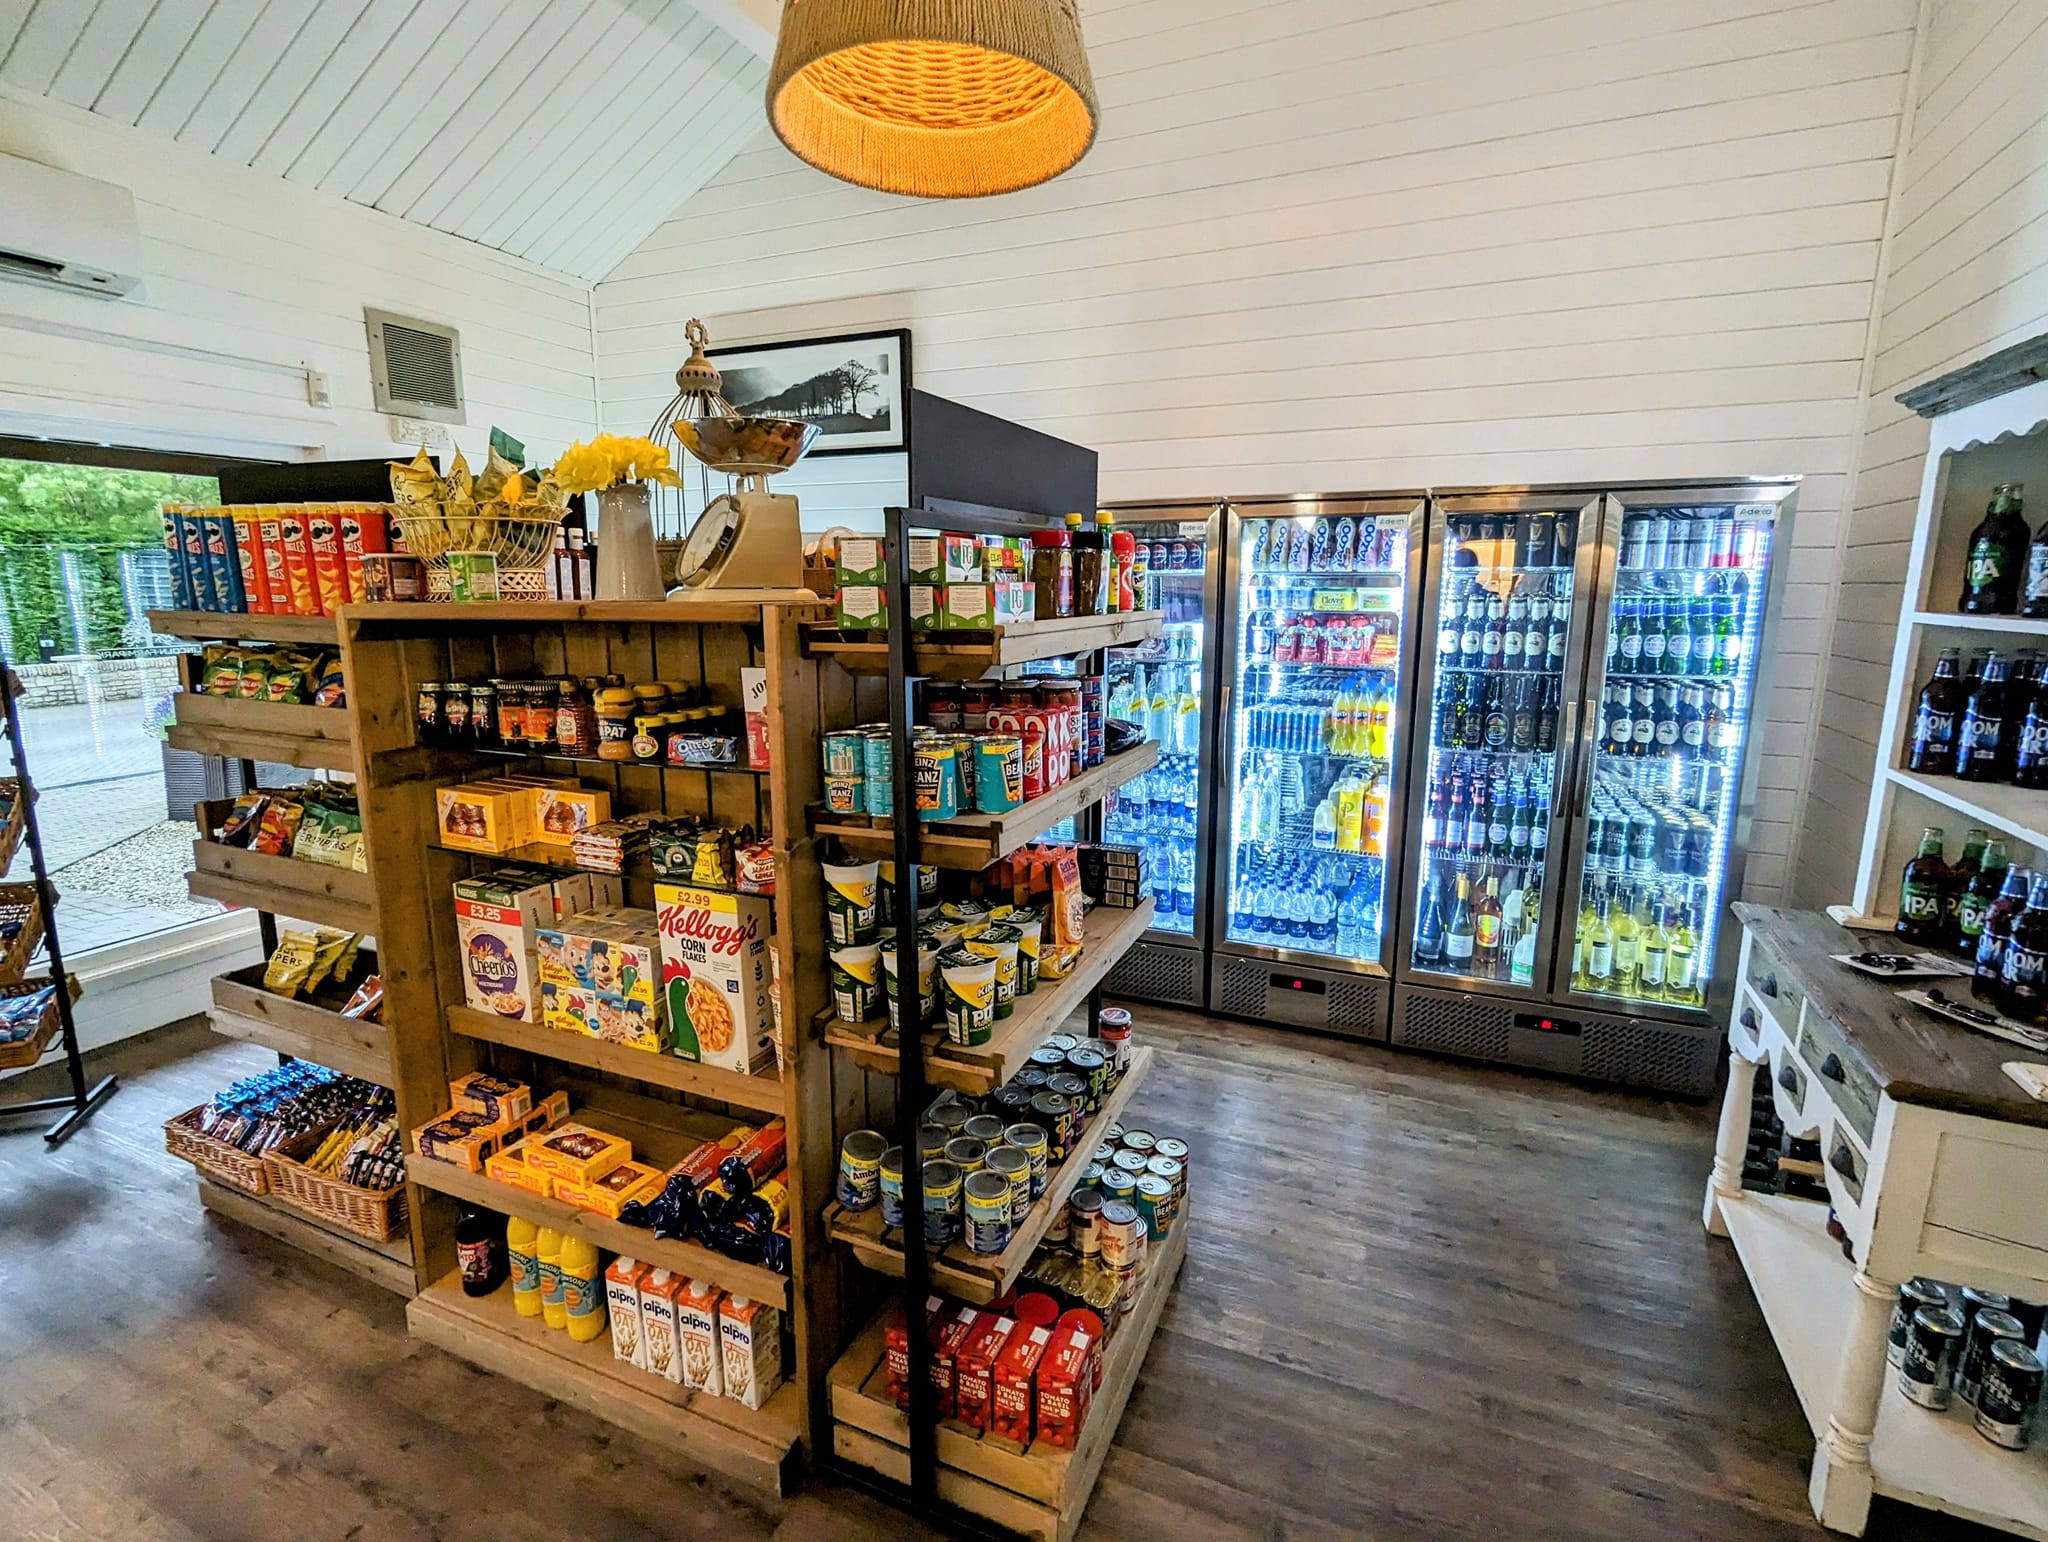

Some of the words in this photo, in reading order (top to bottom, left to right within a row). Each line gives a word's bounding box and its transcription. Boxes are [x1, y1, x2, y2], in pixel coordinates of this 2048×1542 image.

[1271, 526, 1287, 563] YAZOO
[1289, 531, 1305, 563] YAZO
[1311, 526, 1327, 563] YAZOO
[1332, 525, 1351, 563] YAZOO
[1354, 524, 1375, 563] YAZOO
[963, 544, 972, 565] PG
[1967, 557, 2000, 581] IPA
[1012, 588, 1021, 609] PG
[1321, 595, 1344, 606] Clover
[1915, 714, 1953, 730] OOM
[1960, 719, 2000, 736] OOM
[677, 740, 713, 753] OREO
[914, 757, 936, 769] EINZ
[1006, 763, 1021, 776] BEA
[1024, 758, 1041, 776] BIS
[831, 781, 849, 790] HEINZ
[914, 771, 939, 784] ANZ
[830, 788, 853, 797] BEANZ
[755, 871, 774, 879] GINGE
[919, 870, 937, 888] PO
[677, 891, 710, 906] £2.99
[862, 885, 877, 897] KIN
[470, 904, 502, 921] £3.25
[1904, 894, 1939, 915] IPA
[1946, 898, 1962, 918] PA
[857, 906, 876, 923] PO
[659, 904, 759, 956] Kellogg's
[681, 938, 706, 953] CORN
[749, 938, 764, 952] CORN
[682, 951, 706, 963] FLAKES
[1002, 958, 1018, 973] KIN
[2004, 948, 2045, 972] OOM
[470, 956, 516, 978] Cheerios
[977, 984, 994, 998] KIN
[997, 981, 1015, 998] PO
[971, 1005, 994, 1024] PO
[853, 1167, 880, 1181] Ambr
[609, 1289, 636, 1306] alpro
[643, 1300, 672, 1320] alpro
[613, 1312, 636, 1334] OAT
[681, 1313, 711, 1332] alpro
[649, 1324, 671, 1348] OAT
[721, 1324, 750, 1345] alpro
[685, 1337, 710, 1362] OAT
[888, 1349, 908, 1360] TOMA
[727, 1349, 749, 1374] OAT
[930, 1370, 950, 1381] ASIL
[931, 1365, 950, 1376] MATO
[960, 1373, 987, 1386] TOMATO
[966, 1380, 987, 1392] BASIL
[996, 1384, 1025, 1398] TOMATO
[1003, 1392, 1024, 1404] BASIL
[1040, 1391, 1070, 1405] TOMATO
[1047, 1398, 1070, 1410] BASIL
